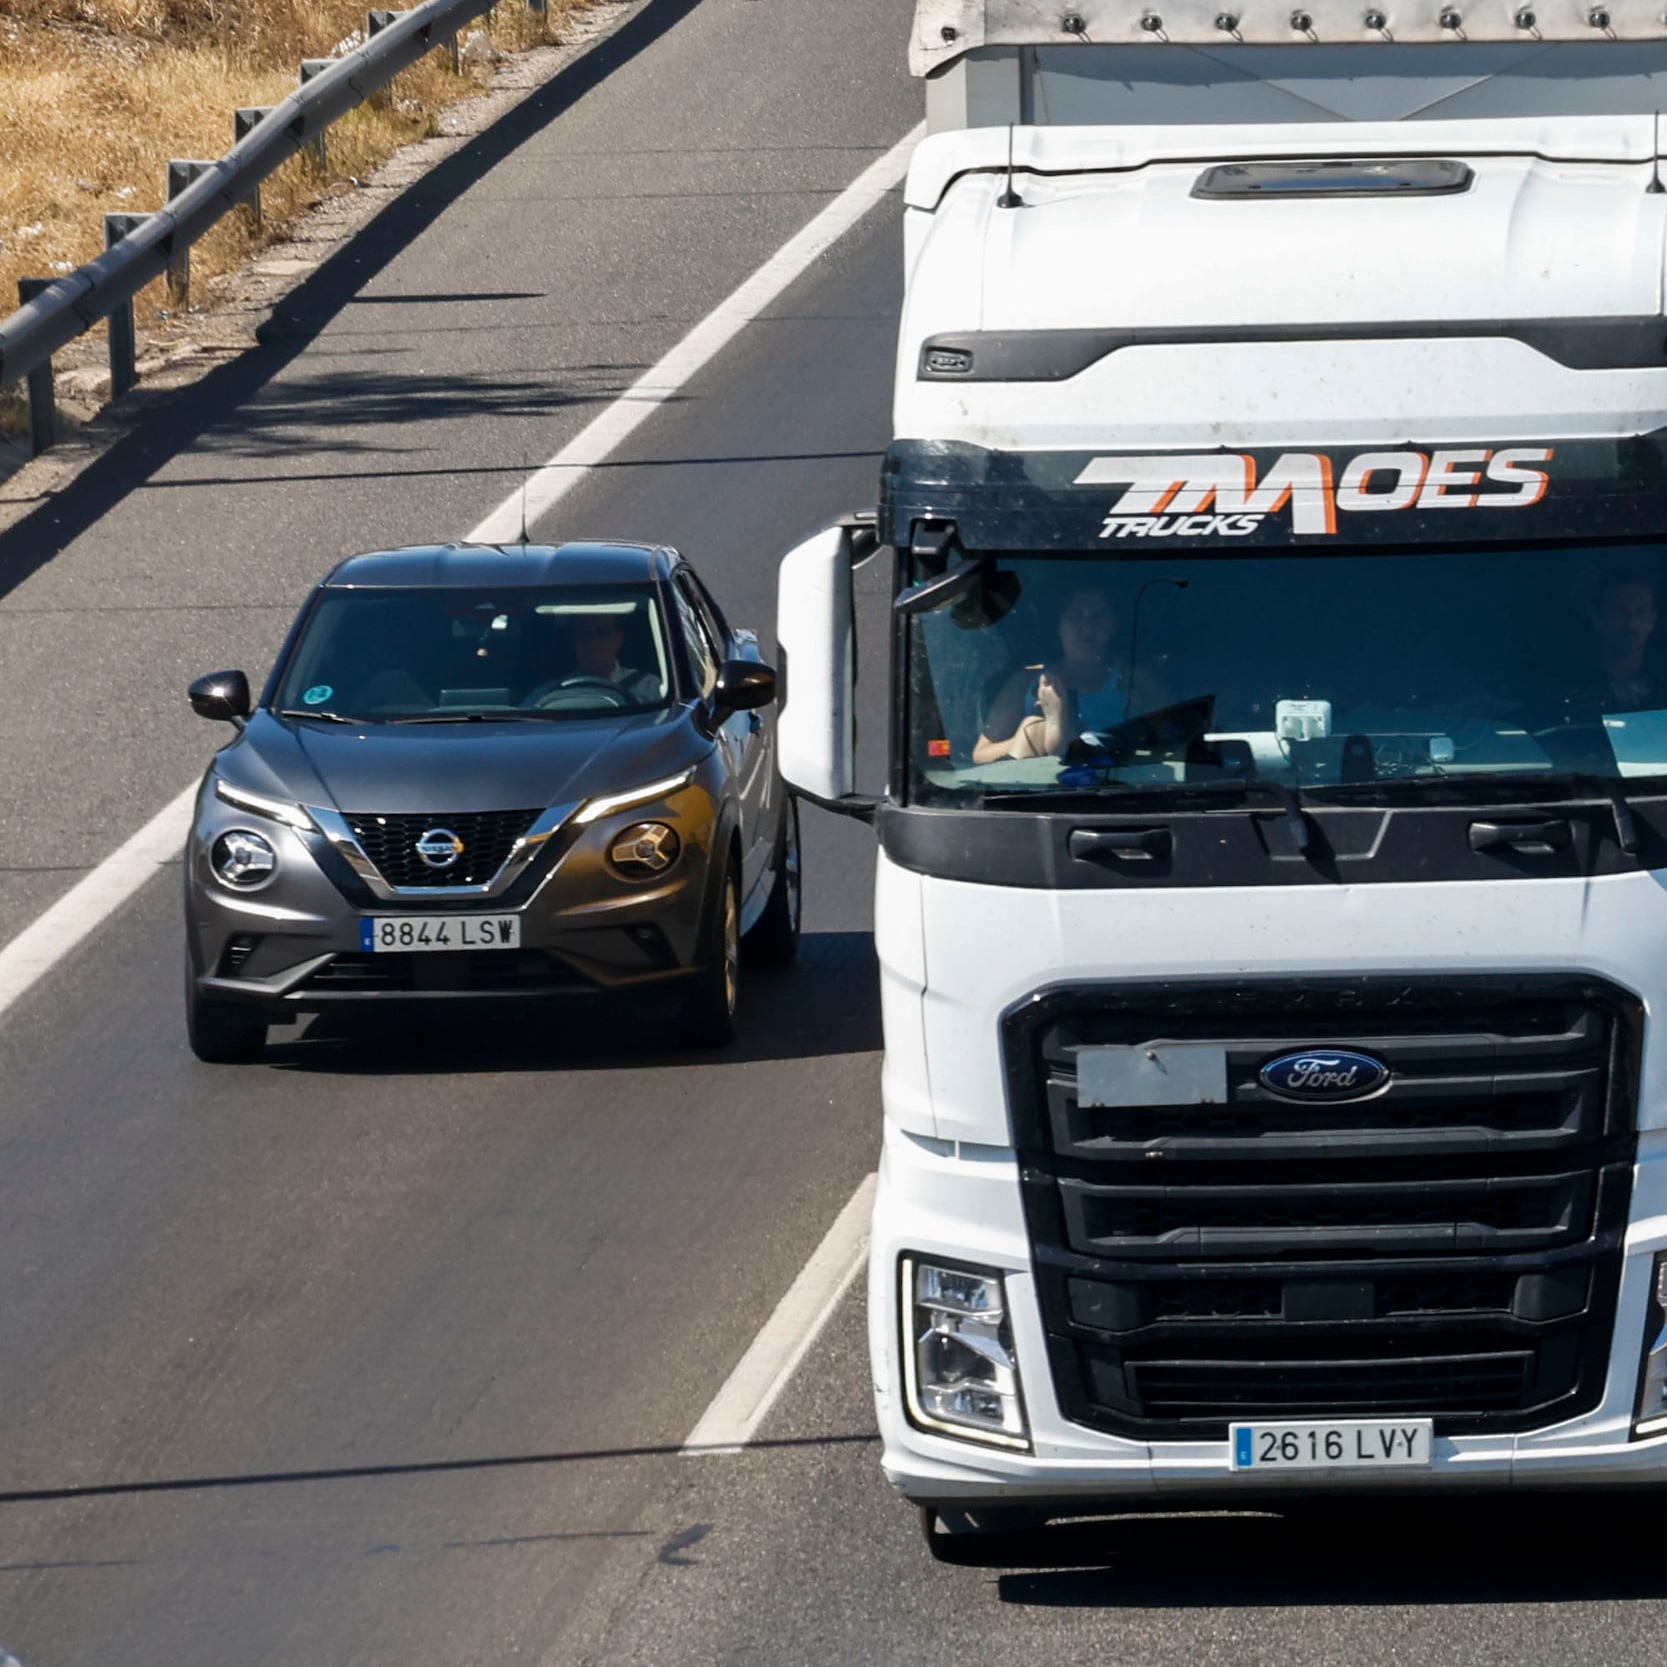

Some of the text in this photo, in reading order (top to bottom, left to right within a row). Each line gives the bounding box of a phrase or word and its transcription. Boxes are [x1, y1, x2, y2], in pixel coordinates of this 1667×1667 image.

[1099, 513, 1267, 538] TRUCKS
[380, 920, 516, 947] 8844 LSW
[1287, 1058, 1358, 1088] Ford
[1259, 1427, 1420, 1463] 2616 LVY
